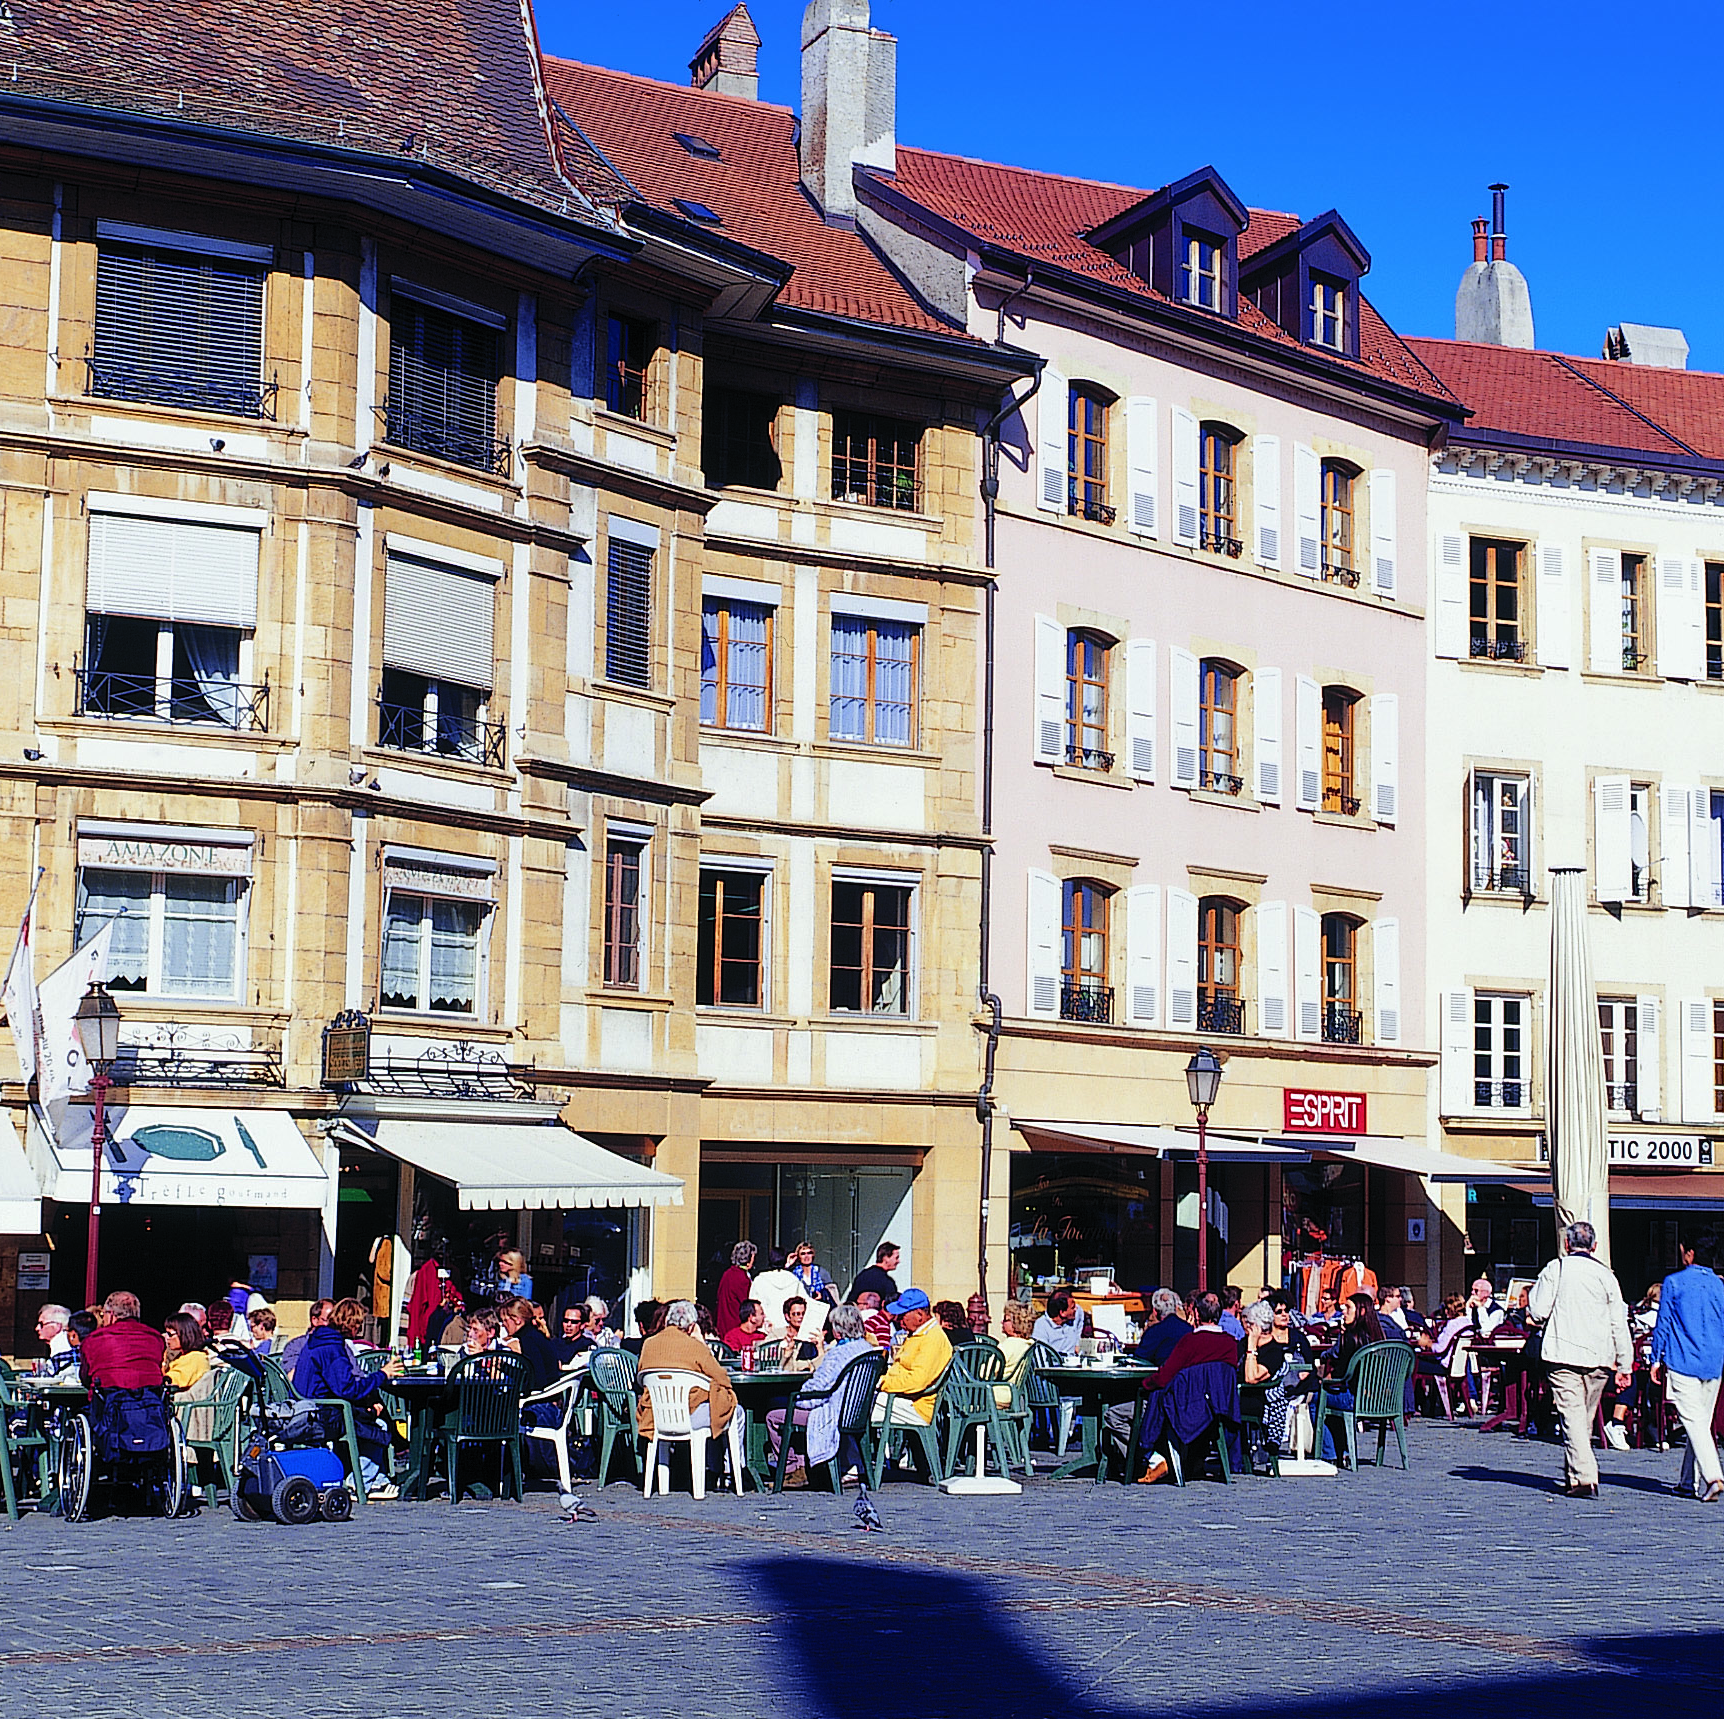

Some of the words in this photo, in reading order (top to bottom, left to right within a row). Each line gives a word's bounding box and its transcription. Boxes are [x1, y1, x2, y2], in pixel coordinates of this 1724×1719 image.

[106, 840, 219, 866] AMAZONE
[1290, 1093, 1362, 1129] ESPRIT
[1608, 1139, 1640, 1159] TIC
[1646, 1141, 1693, 1160] 2000
[216, 1185, 288, 1206] gourmand
[1468, 1188, 1478, 1202] R
